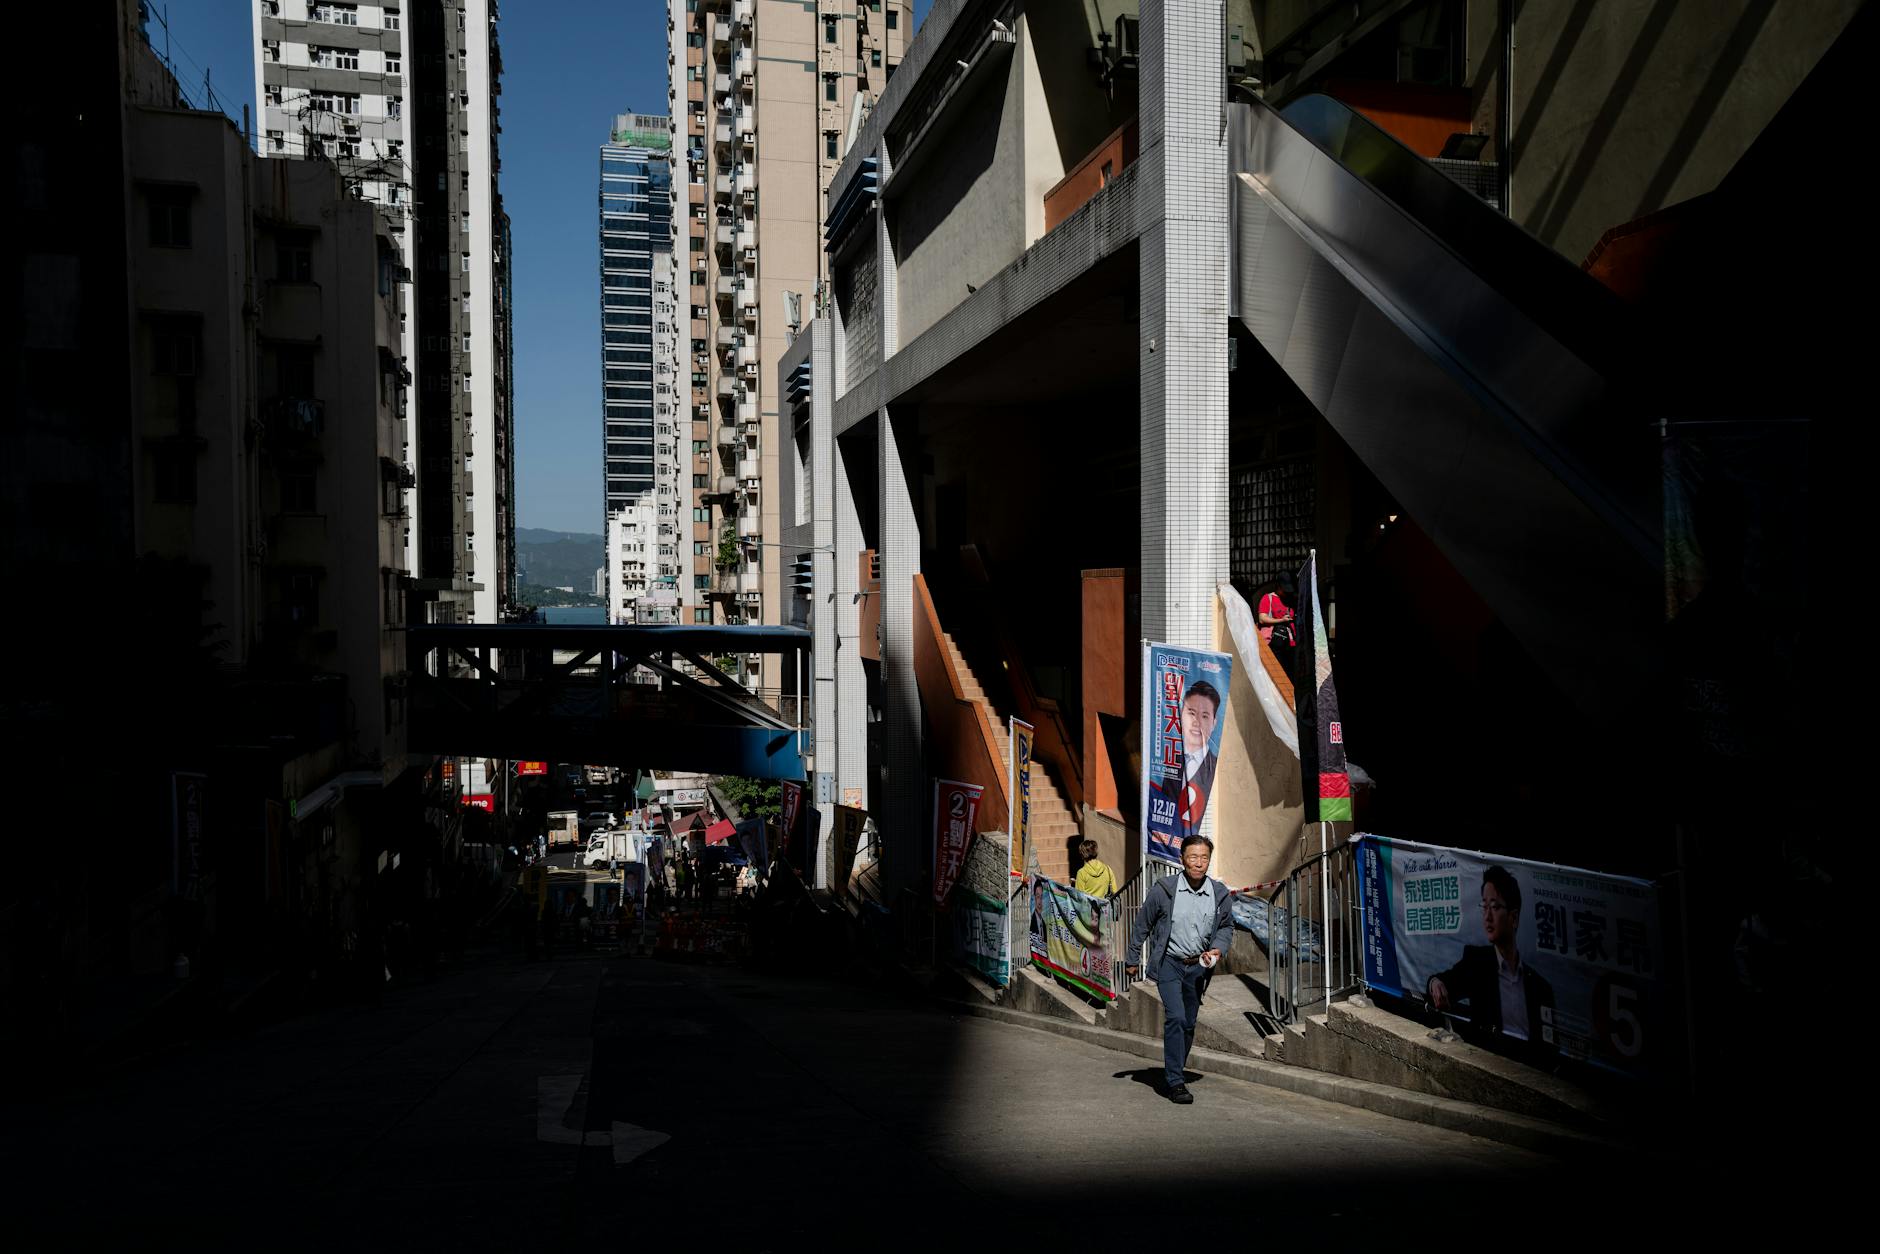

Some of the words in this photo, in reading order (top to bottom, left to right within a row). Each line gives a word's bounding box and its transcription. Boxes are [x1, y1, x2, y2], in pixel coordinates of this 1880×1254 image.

[951, 793, 964, 815] 2
[1153, 798, 1176, 818] 12.10
[1404, 876, 1459, 903] 家港同路
[1406, 906, 1461, 931] 昂首闊步
[1535, 901, 1653, 974] 劉家昂
[1608, 984, 1643, 1056] 5
